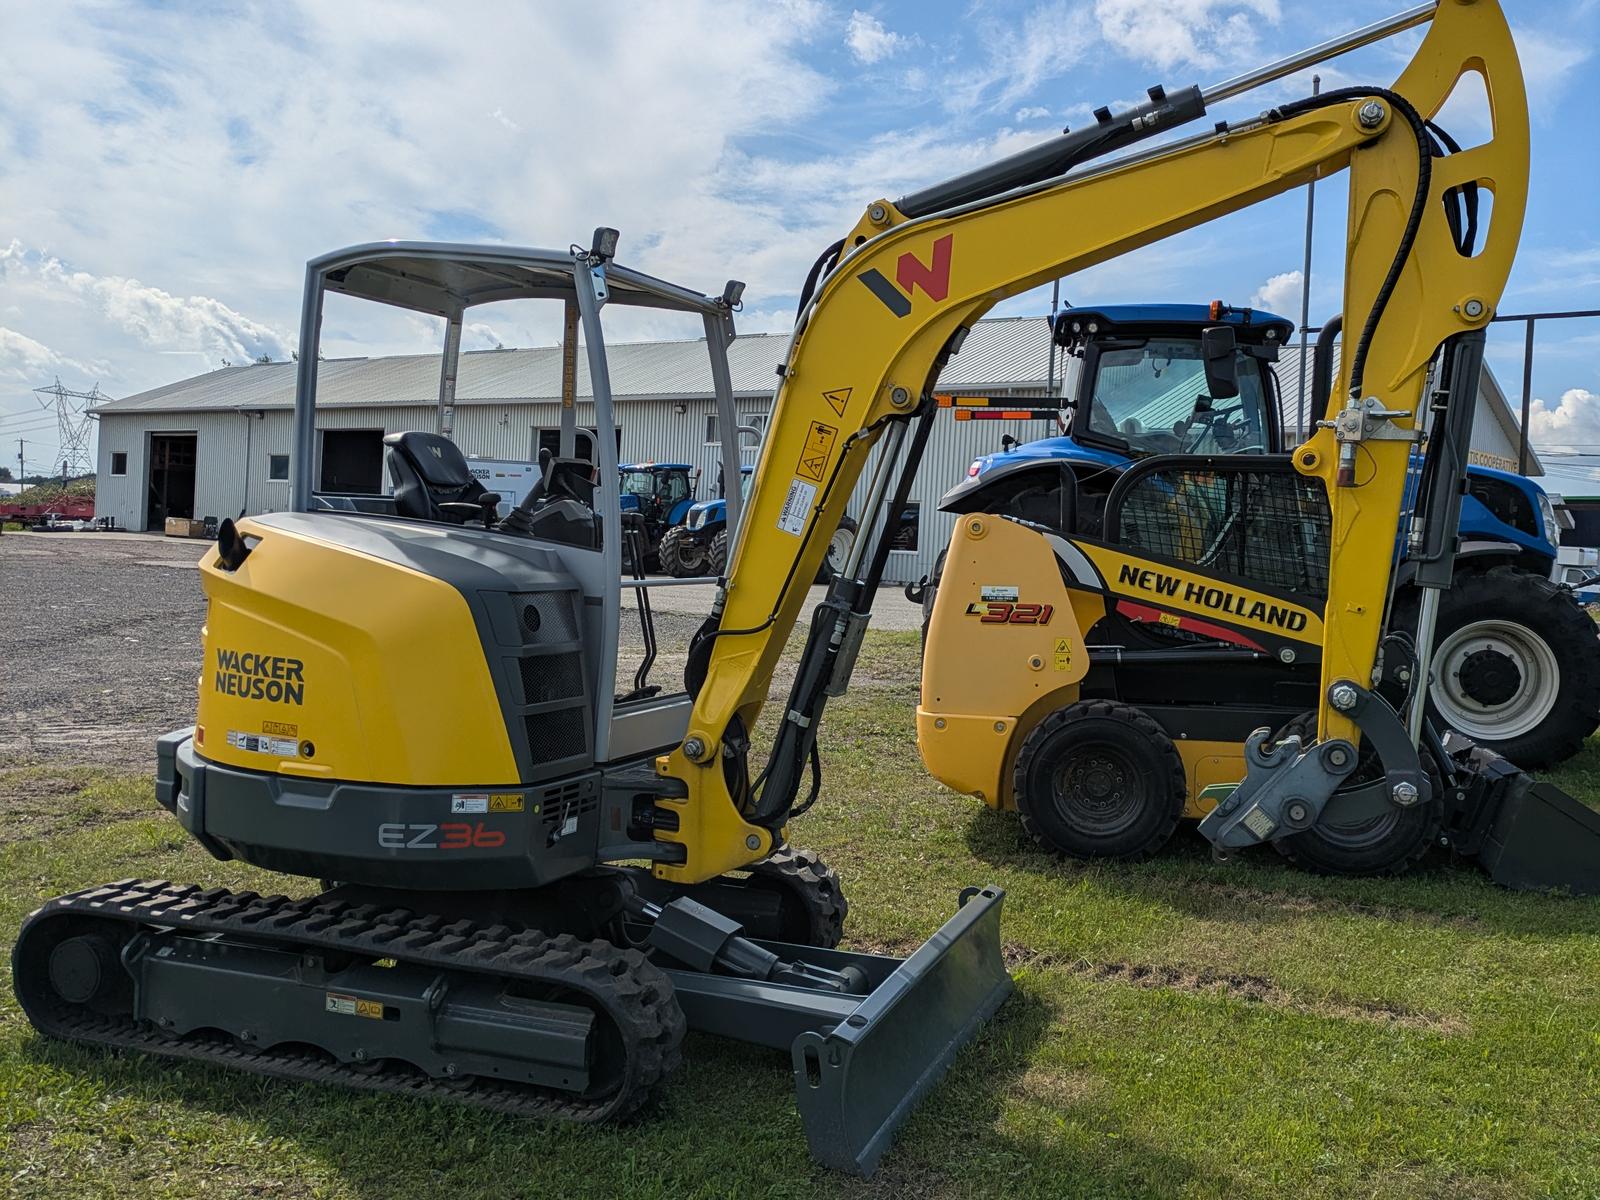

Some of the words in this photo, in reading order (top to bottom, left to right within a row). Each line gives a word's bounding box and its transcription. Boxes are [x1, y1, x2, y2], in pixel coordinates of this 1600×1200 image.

[782, 486, 797, 516] WARNING
[1118, 564, 1181, 597] NEW
[1184, 582, 1307, 632] HOLLAND
[217, 648, 304, 682] WACKER
[216, 671, 304, 706] NEUSON
[378, 822, 506, 849] EZ36
